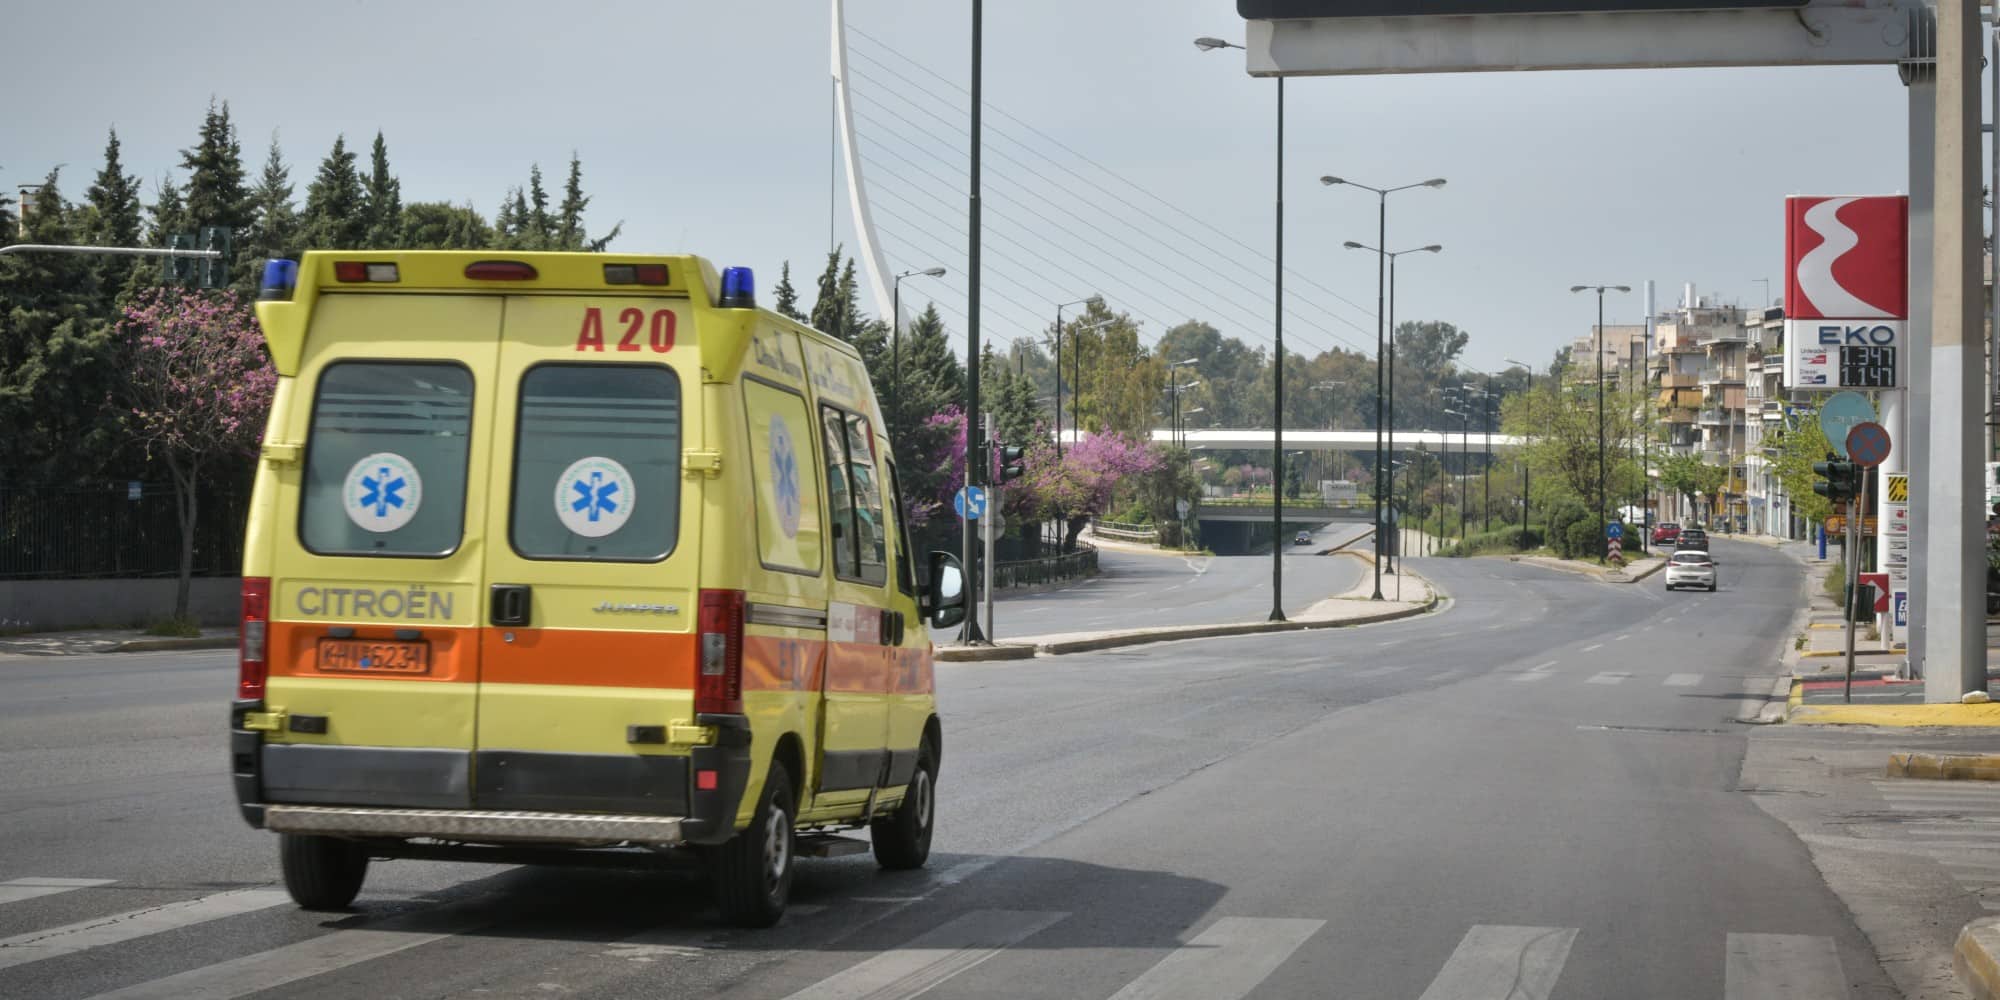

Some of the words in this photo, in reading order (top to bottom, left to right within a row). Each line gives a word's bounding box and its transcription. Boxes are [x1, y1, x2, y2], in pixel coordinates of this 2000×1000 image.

[576, 307, 605, 352] A
[617, 307, 677, 354] 20
[1818, 325, 1895, 345] EKO
[1841, 347, 1893, 366] 1.347
[1841, 367, 1893, 386] 1.147
[296, 583, 454, 620] CITROËN
[592, 600, 679, 616] JUMPER
